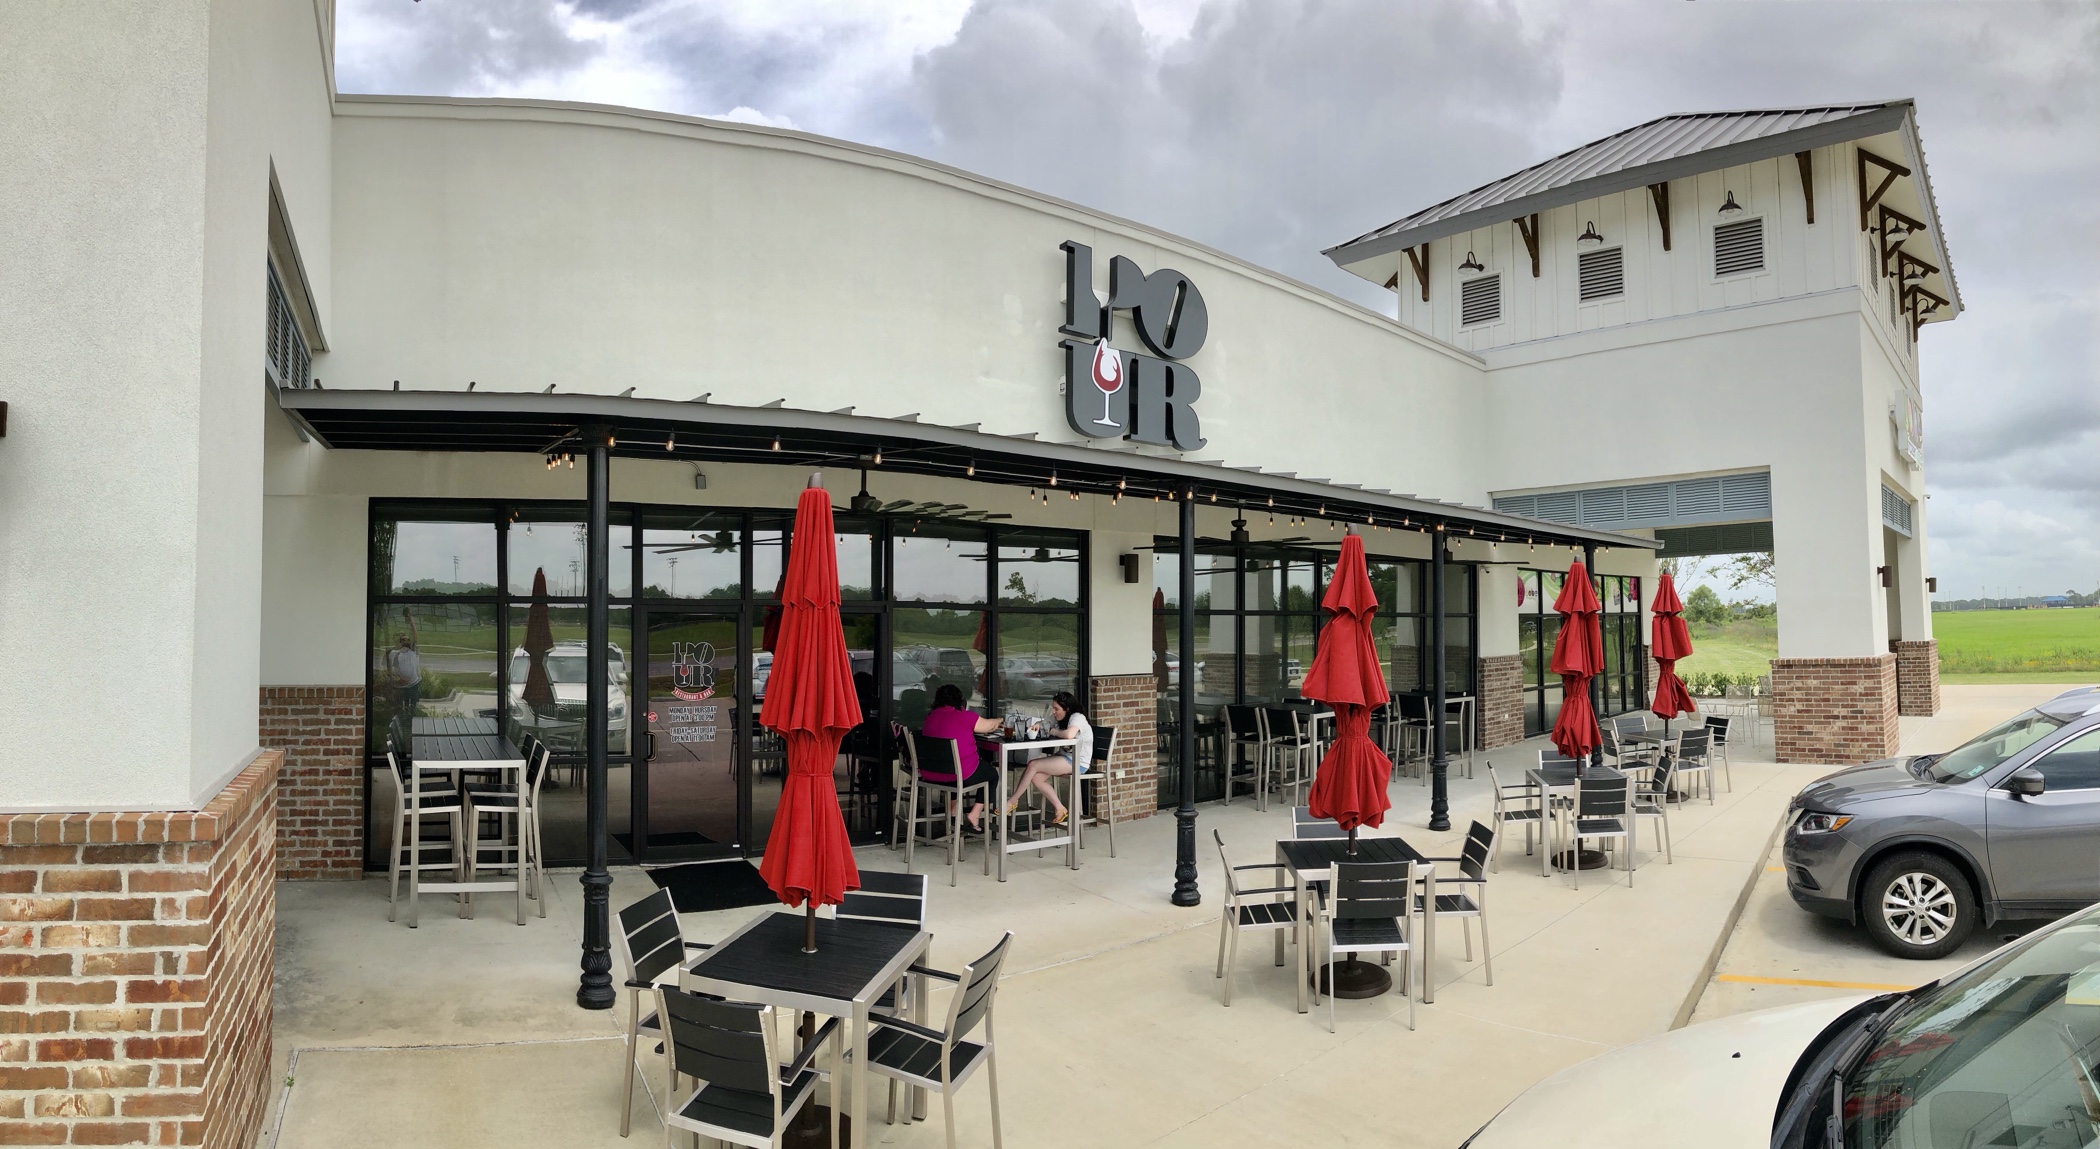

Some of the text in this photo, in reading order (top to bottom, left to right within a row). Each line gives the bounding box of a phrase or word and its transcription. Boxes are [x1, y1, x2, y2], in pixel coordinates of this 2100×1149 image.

[675, 689, 699, 700] RESTAURANT
[672, 714, 685, 722] OPEN
[706, 713, 715, 721] PM
[671, 735, 685, 743] OPEN
[705, 733, 715, 742] AM
